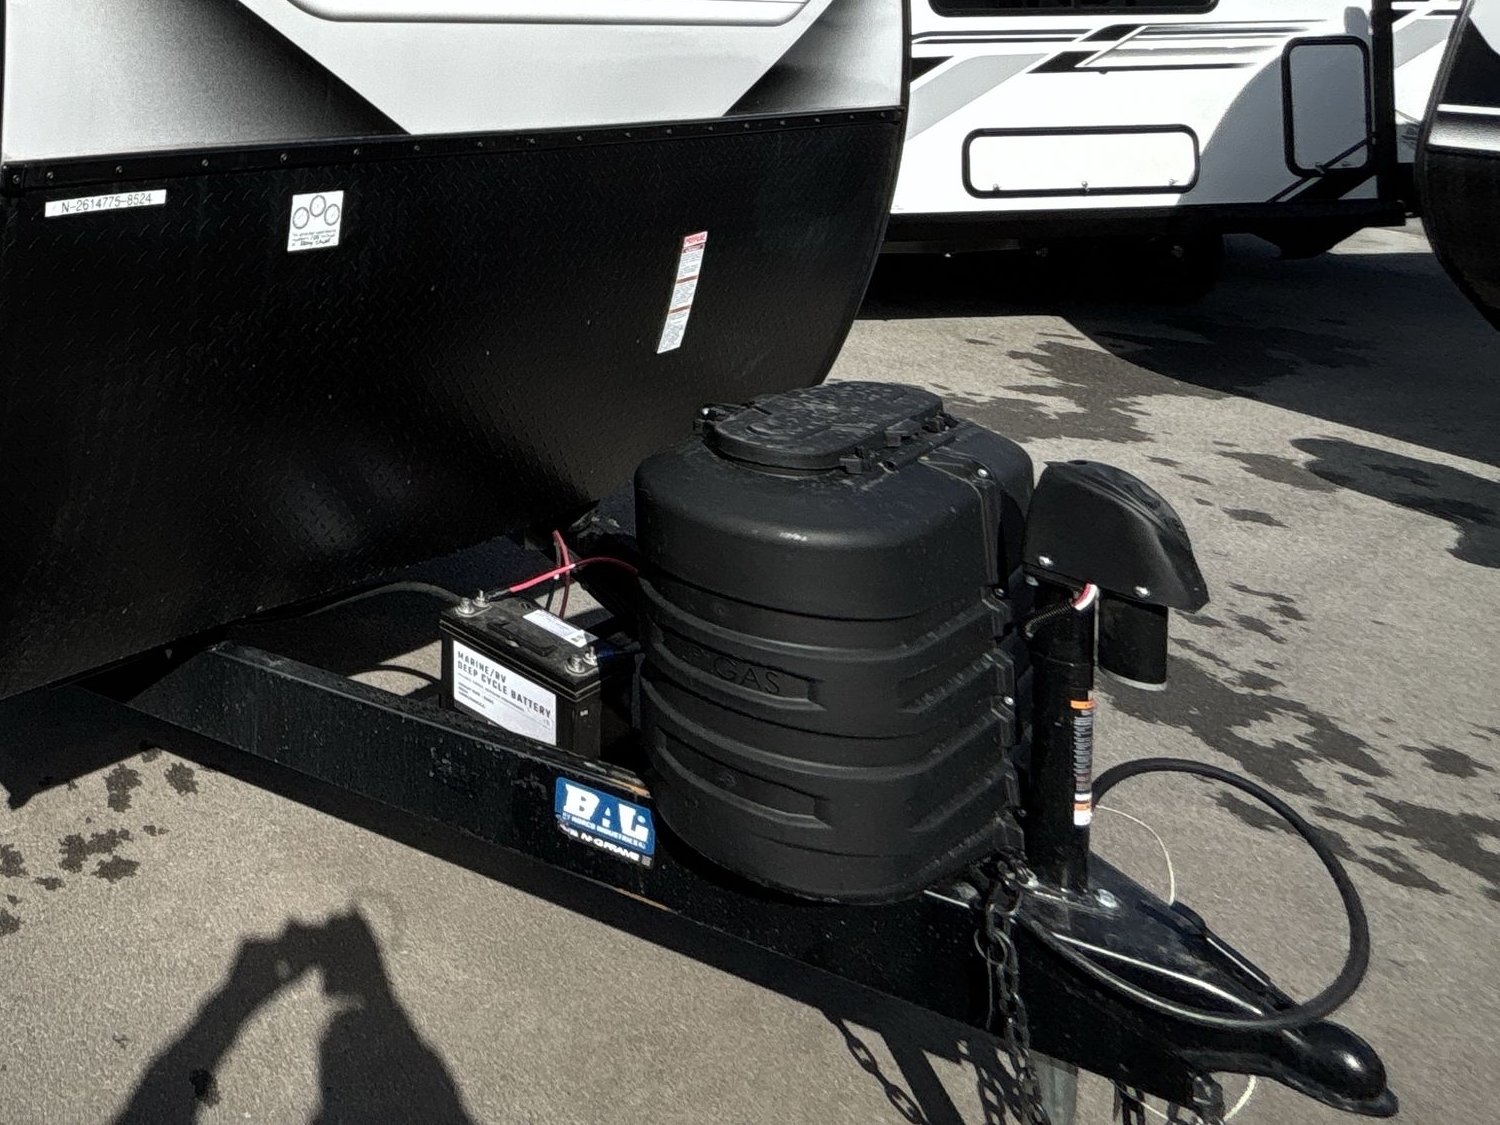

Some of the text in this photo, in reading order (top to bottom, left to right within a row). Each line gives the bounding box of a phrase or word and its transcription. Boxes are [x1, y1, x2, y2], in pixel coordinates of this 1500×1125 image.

[457, 650, 507, 684] MARINE/RV
[713, 656, 780, 695] GAS
[457, 660, 478, 678] DEEP
[481, 673, 508, 696] CYCLE
[510, 690, 551, 719] BATTERY
